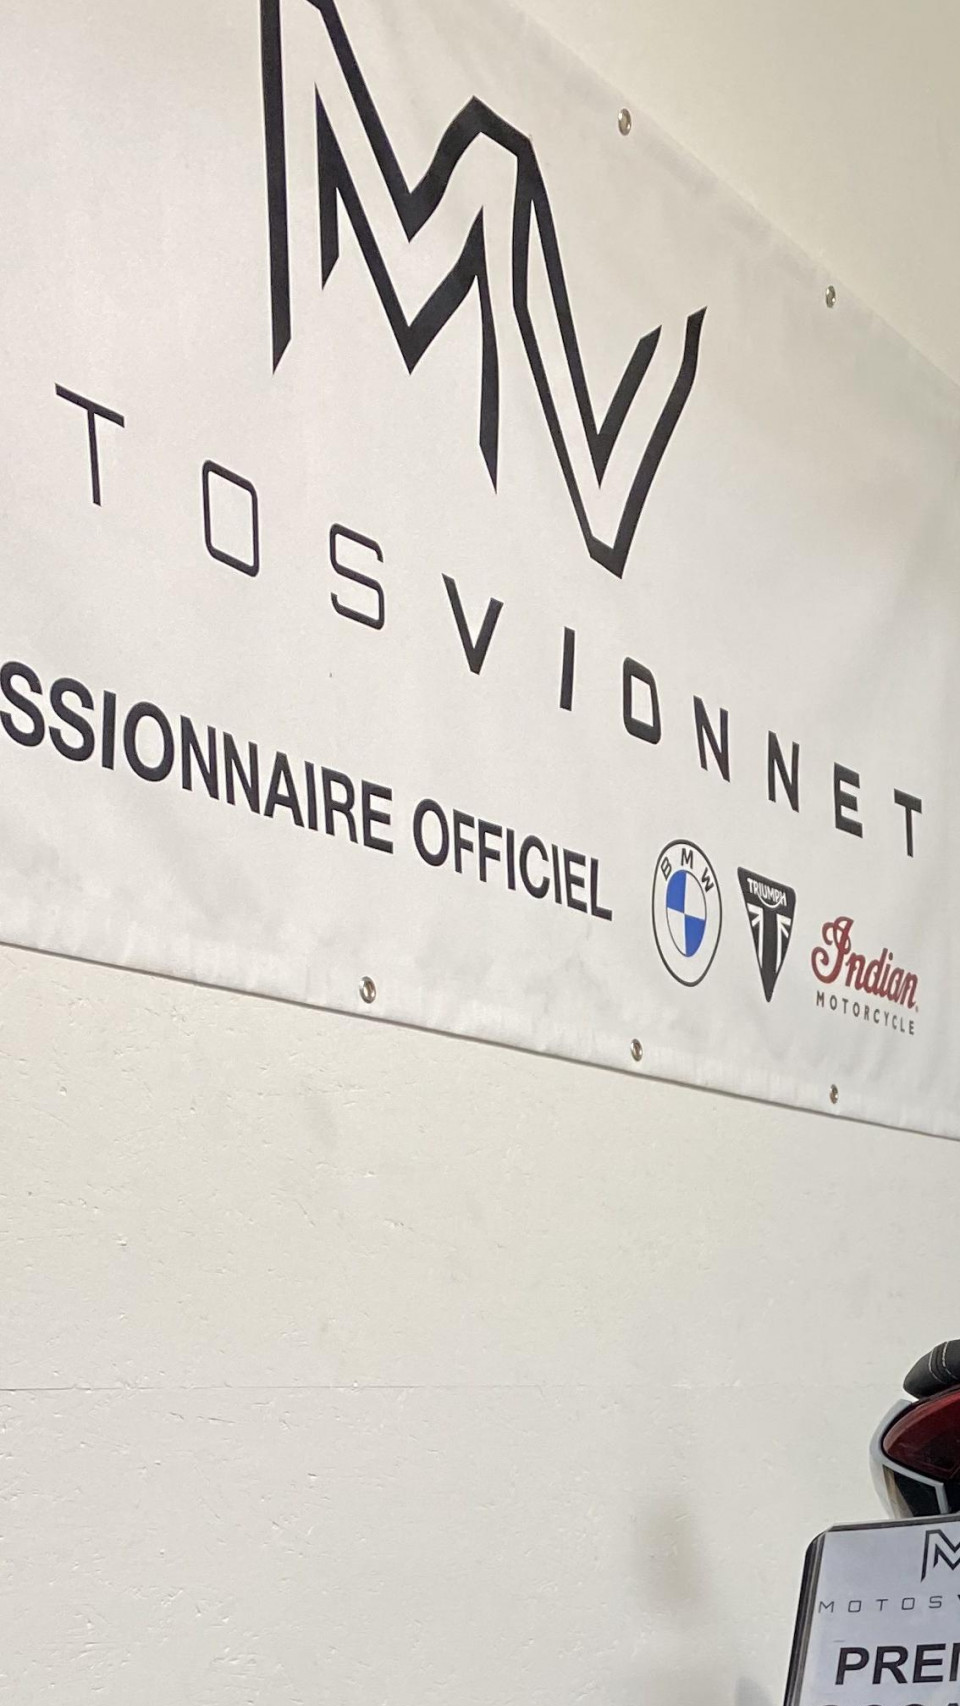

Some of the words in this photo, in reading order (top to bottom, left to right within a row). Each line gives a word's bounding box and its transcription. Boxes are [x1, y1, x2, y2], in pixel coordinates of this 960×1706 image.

[0, 660, 394, 854] SSIONNAIRE
[412, 797, 613, 922] OFFICIEL
[660, 847, 715, 893] BMW
[747, 876, 788, 908] TRIUMPH
[811, 916, 919, 1010] Indian
[815, 989, 915, 1036] MOTORCYCLE
